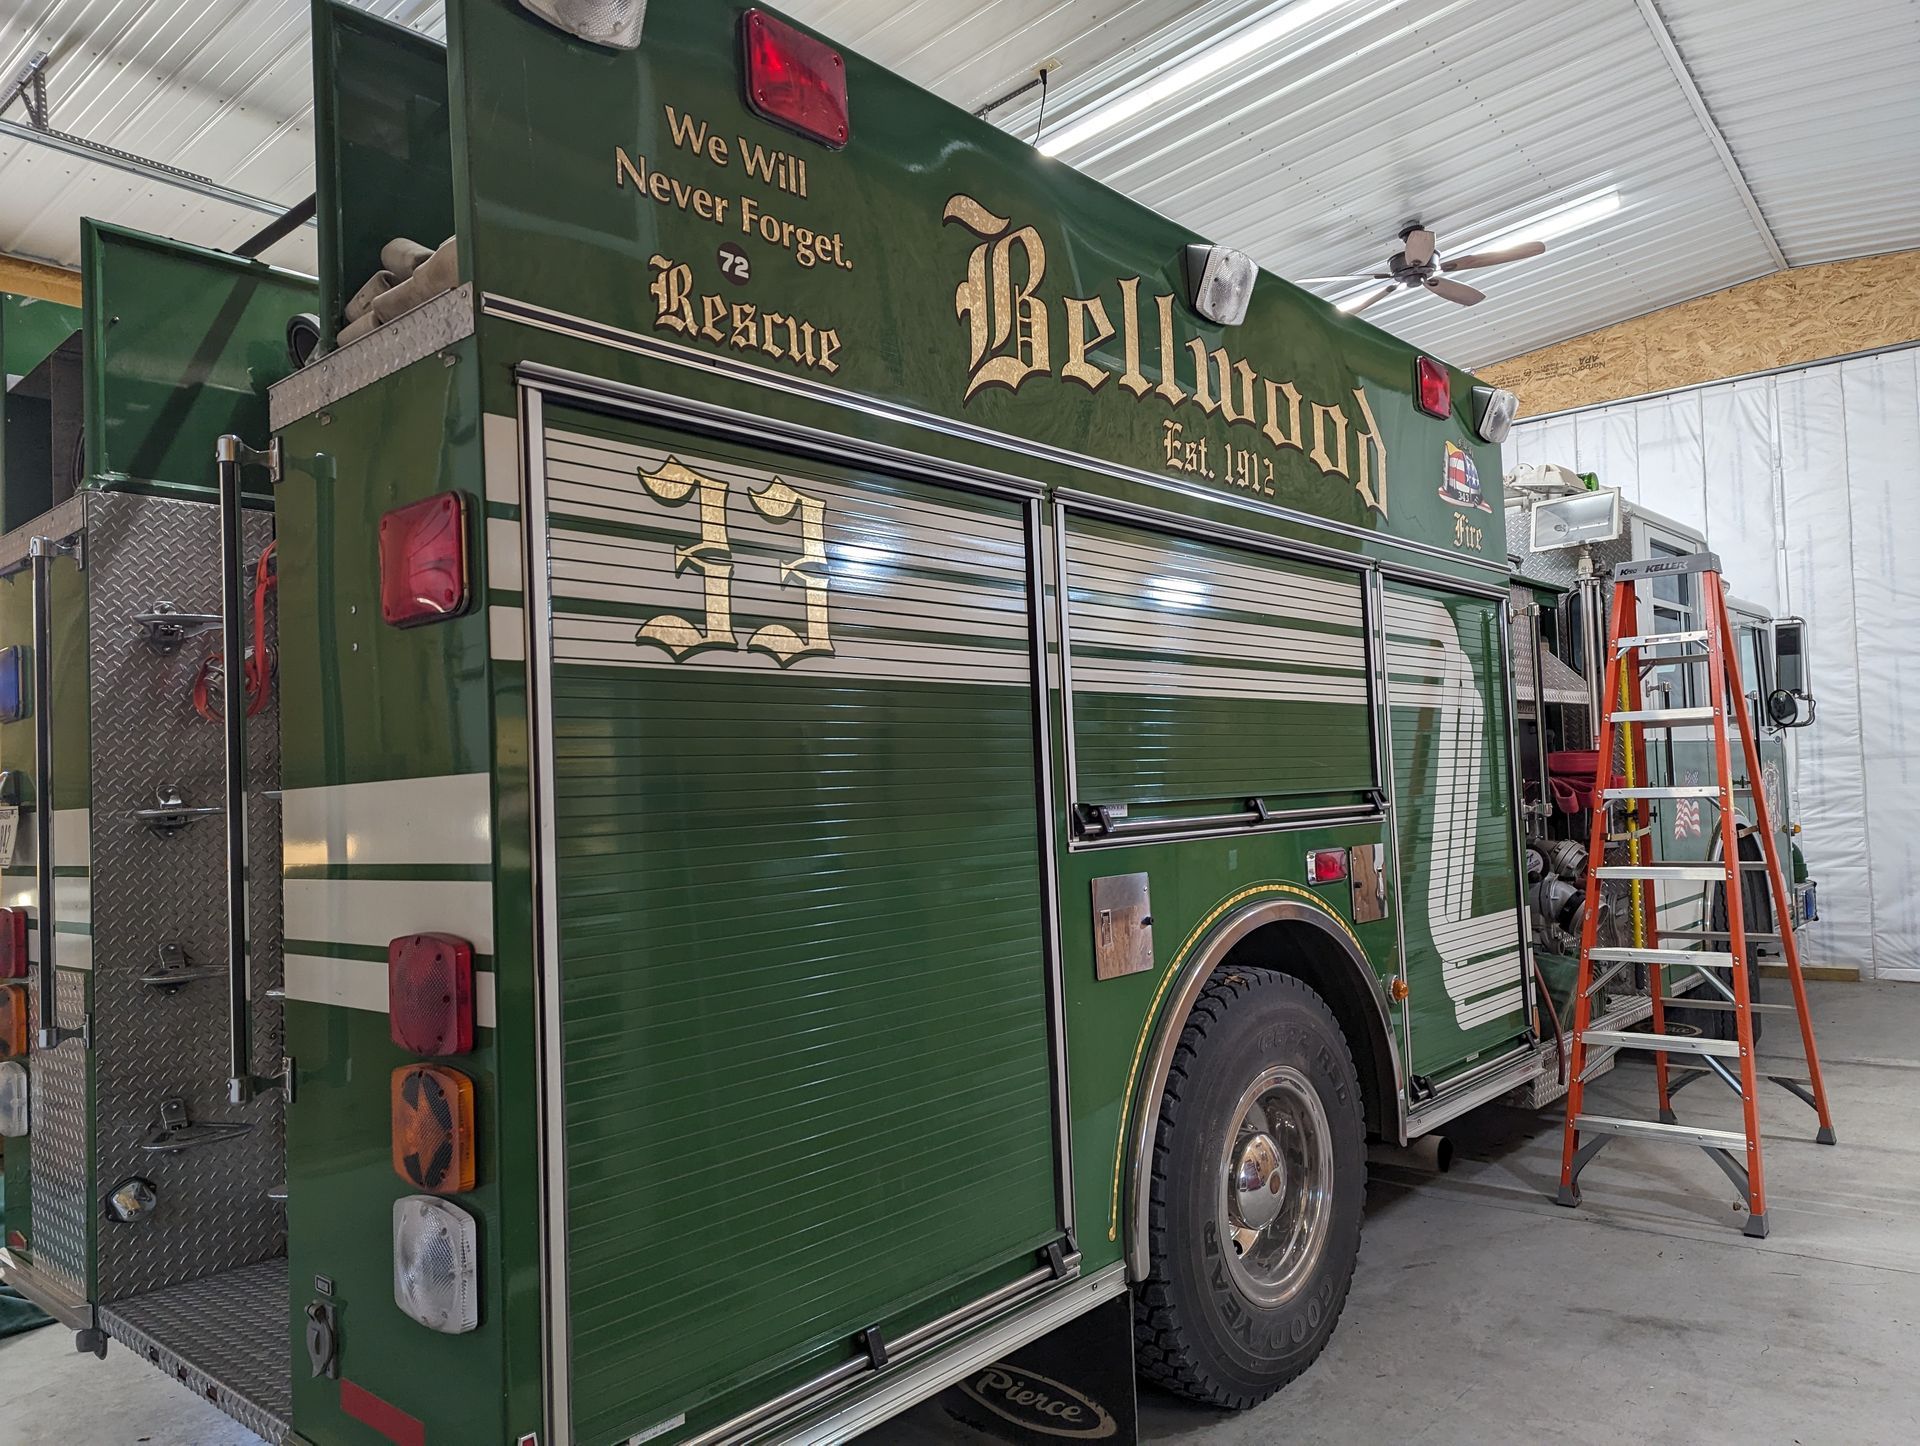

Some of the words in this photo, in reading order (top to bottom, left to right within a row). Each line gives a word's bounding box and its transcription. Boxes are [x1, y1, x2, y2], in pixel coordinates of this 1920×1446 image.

[664, 104, 729, 166] We
[738, 136, 808, 198] Will
[614, 146, 729, 224] Never
[741, 196, 854, 270] Forget.
[718, 250, 750, 280] 72
[649, 254, 843, 374] Rescue
[942, 193, 1389, 520] Bellwood
[1579, 354, 1600, 366] APA
[1162, 418, 1216, 481] Est.
[1224, 443, 1277, 497] 1912
[1458, 491, 1470, 503] 343
[1453, 511, 1483, 551] Fire
[1645, 560, 1689, 574] KELLER
[1203, 1220, 1334, 1350] GOODYEAR
[975, 1368, 1084, 1423] Pierce
